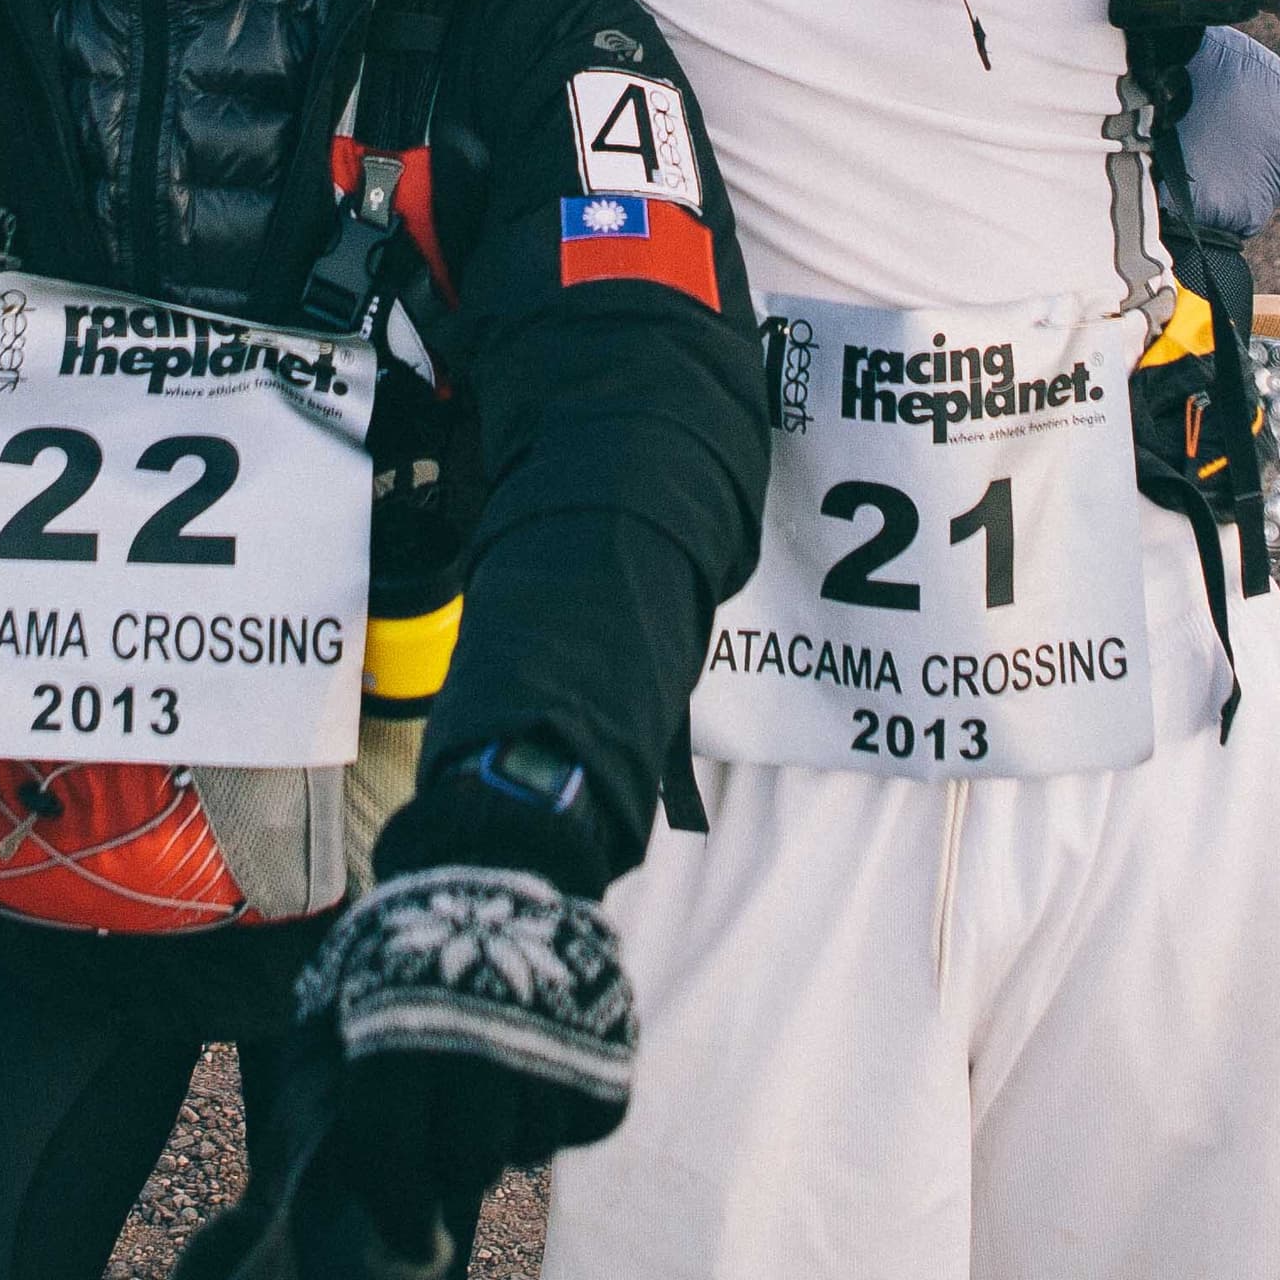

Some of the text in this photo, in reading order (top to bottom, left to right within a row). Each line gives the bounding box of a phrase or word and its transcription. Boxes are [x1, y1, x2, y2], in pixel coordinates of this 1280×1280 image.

[591, 83, 659, 184] 4
[783, 319, 820, 435] deserts
[843, 332, 1014, 392] racing
[820, 477, 1014, 612] 21
[111, 613, 344, 664] CROSSING
[709, 629, 1128, 698] ATACAMA CROSSING
[31, 684, 180, 735] 2013
[851, 708, 989, 761] 2013
